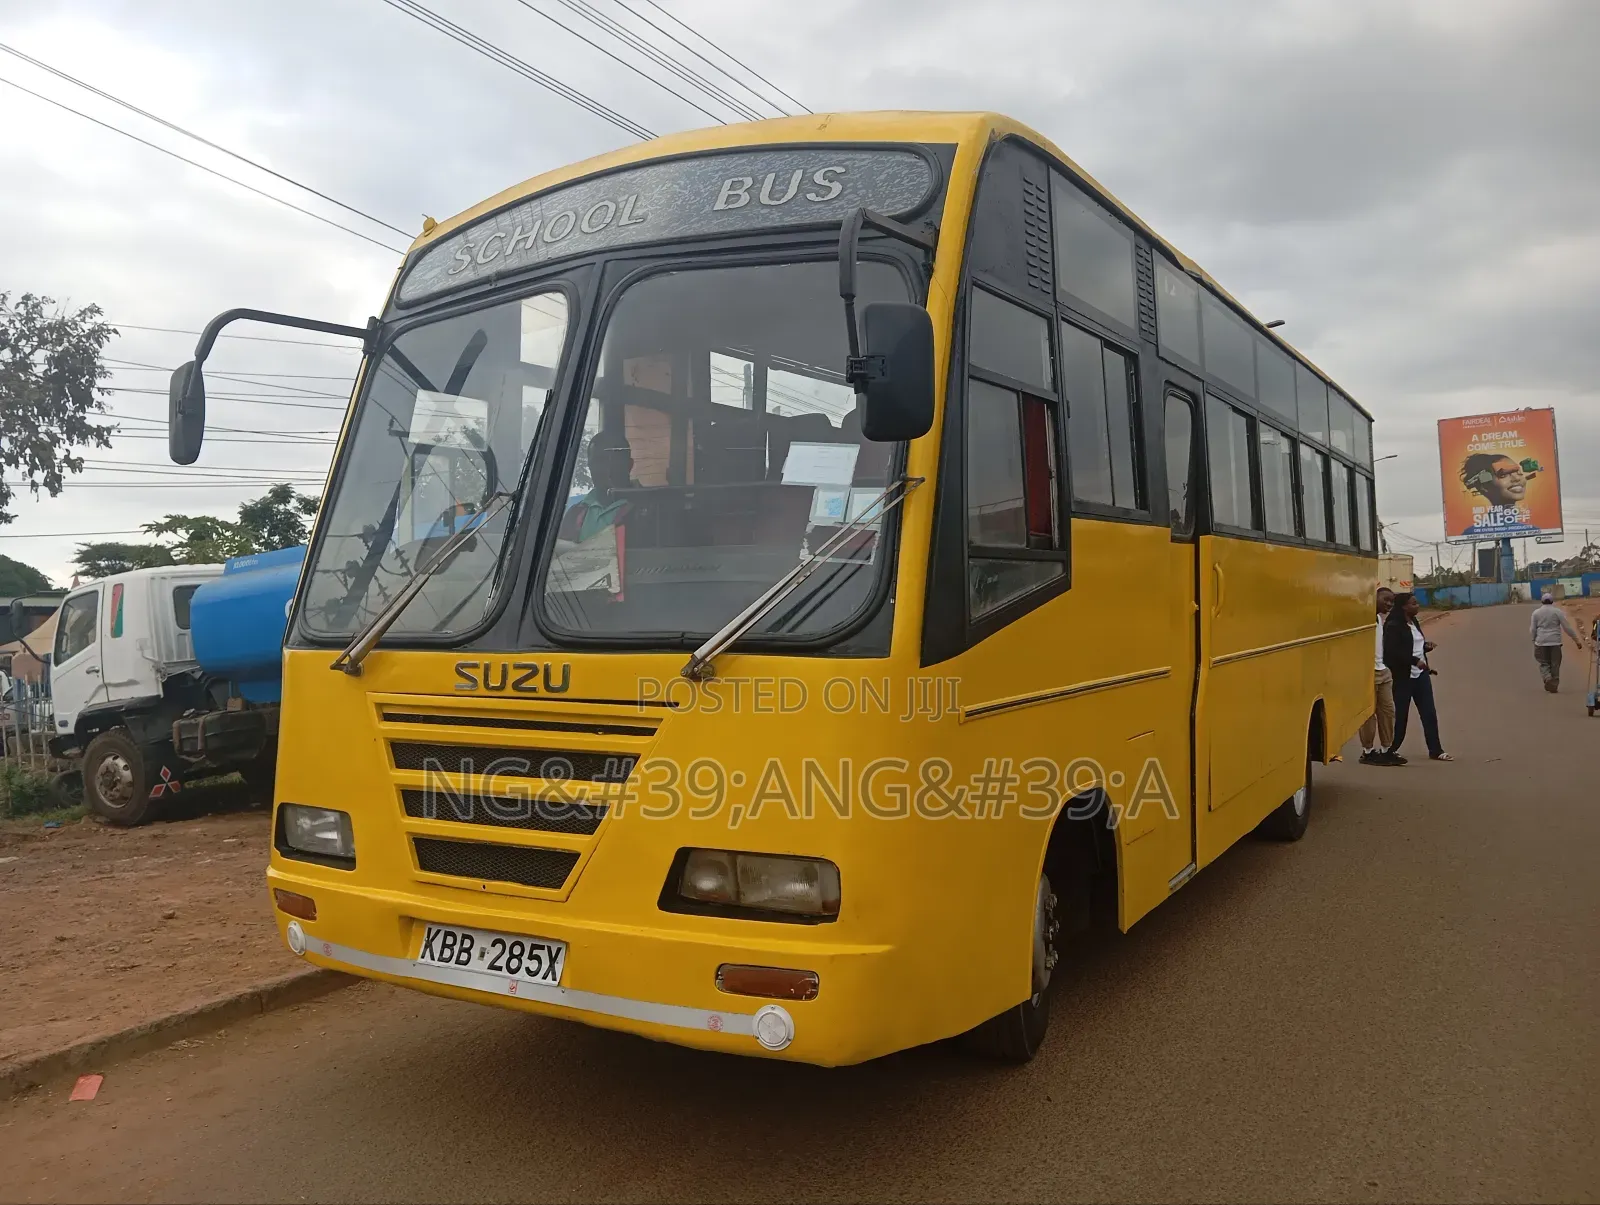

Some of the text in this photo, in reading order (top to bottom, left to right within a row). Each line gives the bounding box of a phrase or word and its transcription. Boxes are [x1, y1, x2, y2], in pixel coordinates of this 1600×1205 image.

[447, 165, 847, 276] SCHOOL BUS
[1471, 430, 1518, 442] A DREAM
[1467, 441, 1497, 452] COME
[1487, 504, 1503, 513] YEAR
[1473, 512, 1505, 528] SALE
[1504, 514, 1531, 524] OFF
[454, 660, 571, 693] SUZU
[420, 927, 562, 982] KBB 285X
